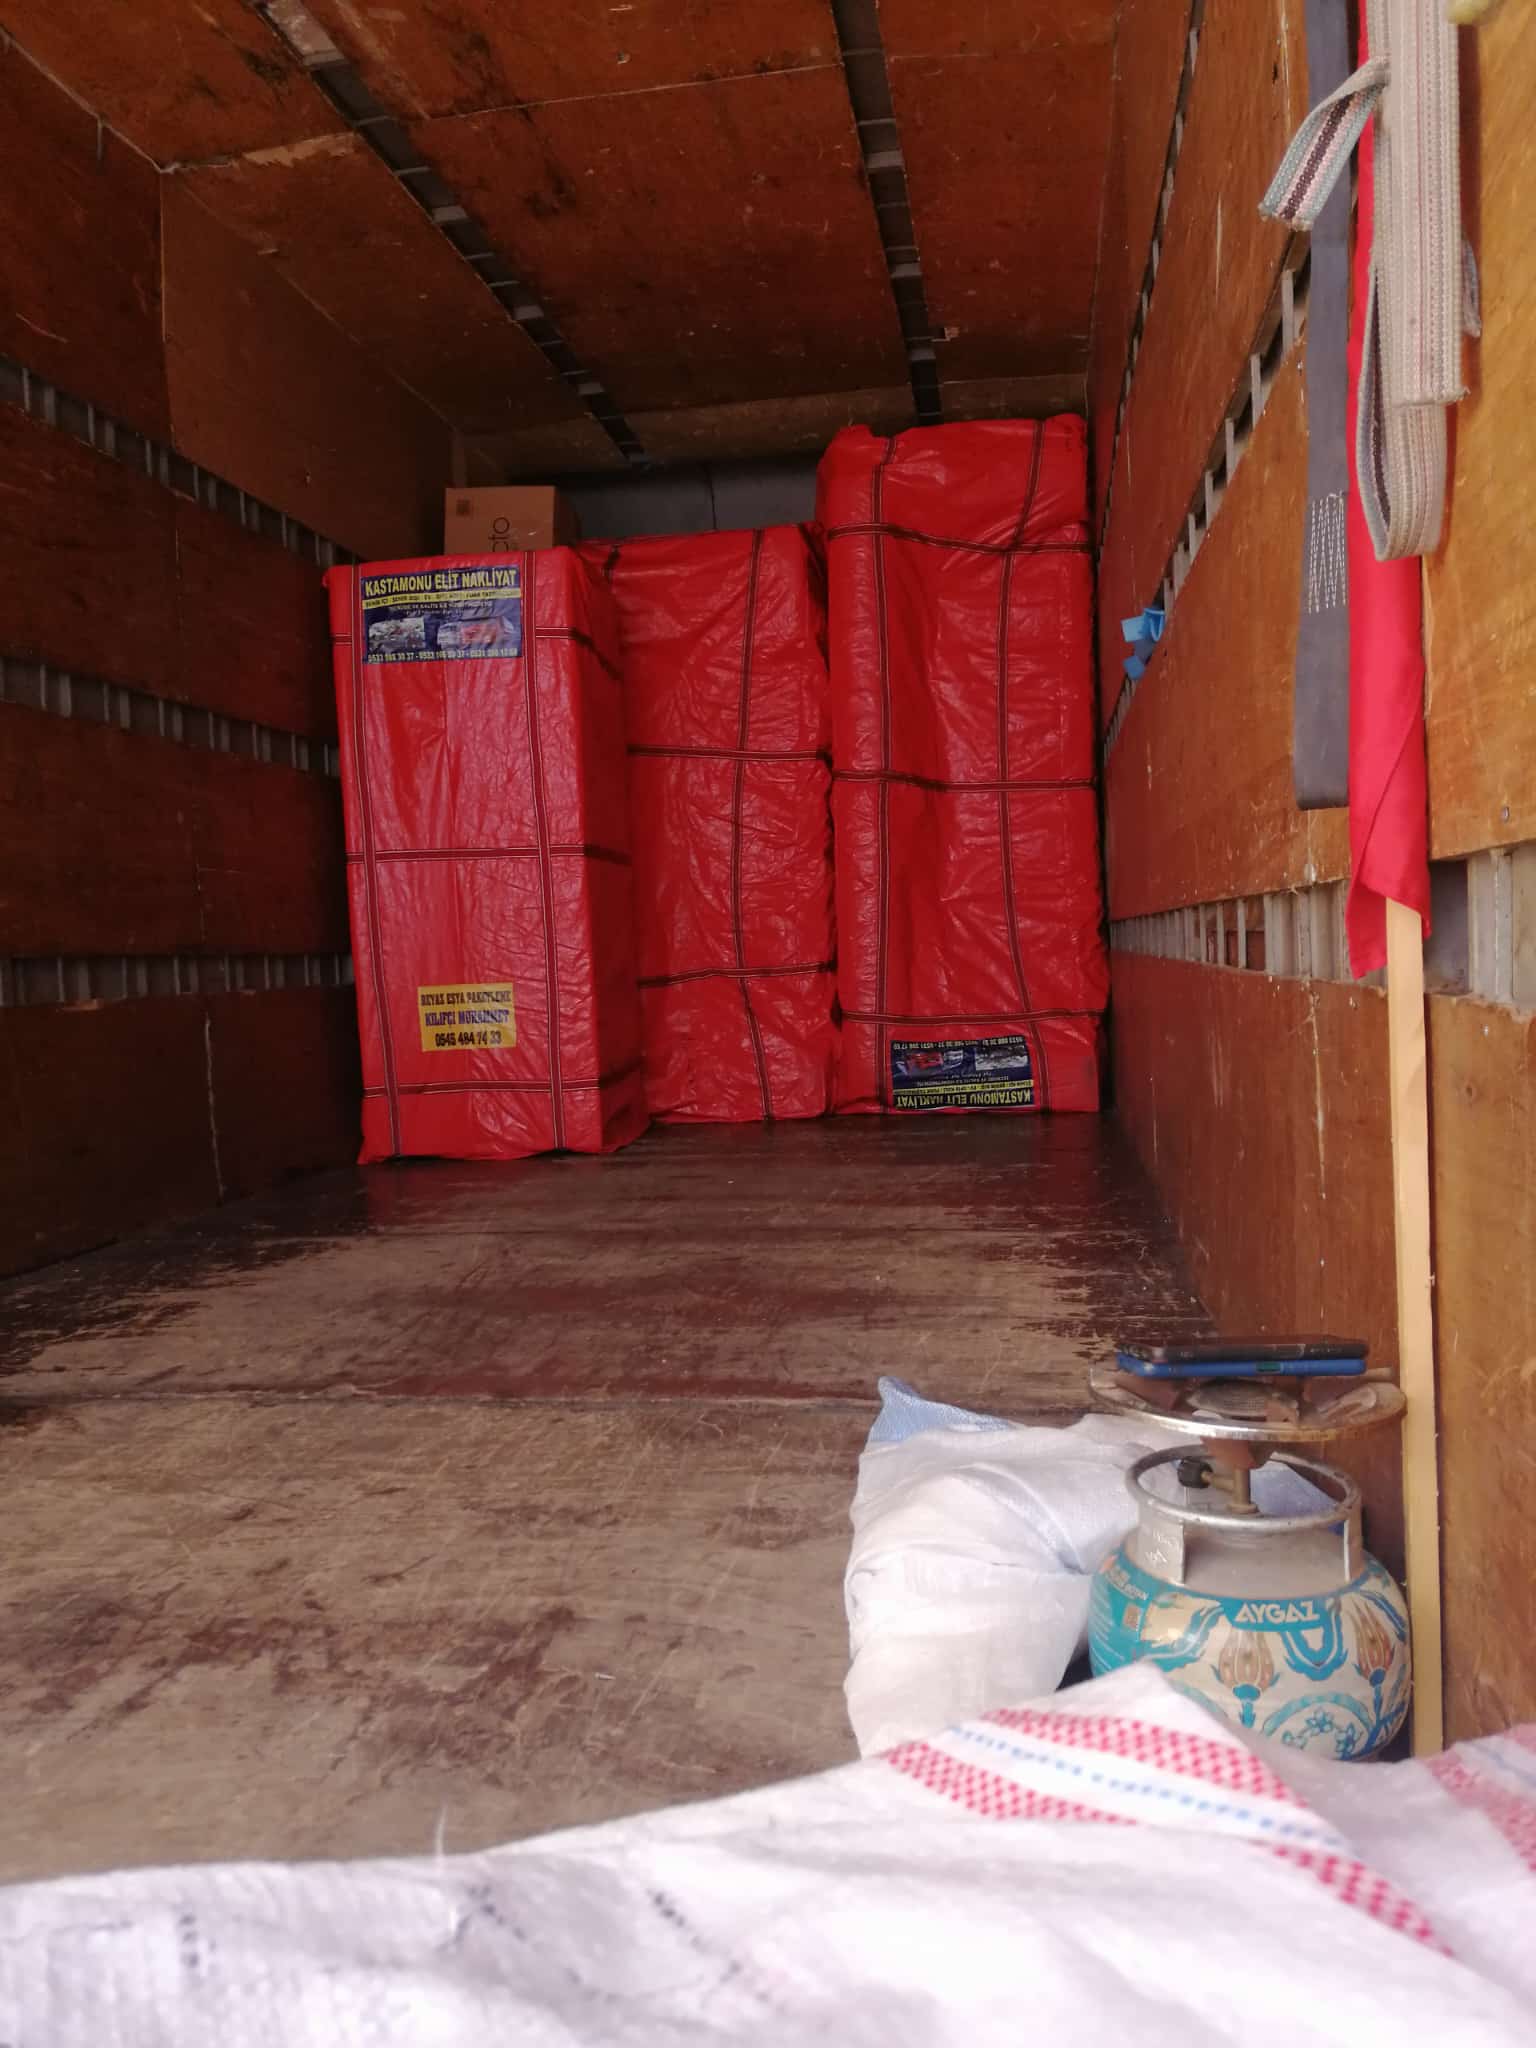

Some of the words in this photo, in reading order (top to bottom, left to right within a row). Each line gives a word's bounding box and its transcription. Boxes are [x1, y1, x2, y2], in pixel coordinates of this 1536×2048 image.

[365, 576, 432, 596] KASTAMONU
[461, 568, 516, 589] NAKLİYAT
[969, 1089, 1031, 1105] KASTAMONU
[1233, 1599, 1321, 1625] AYGAZ
